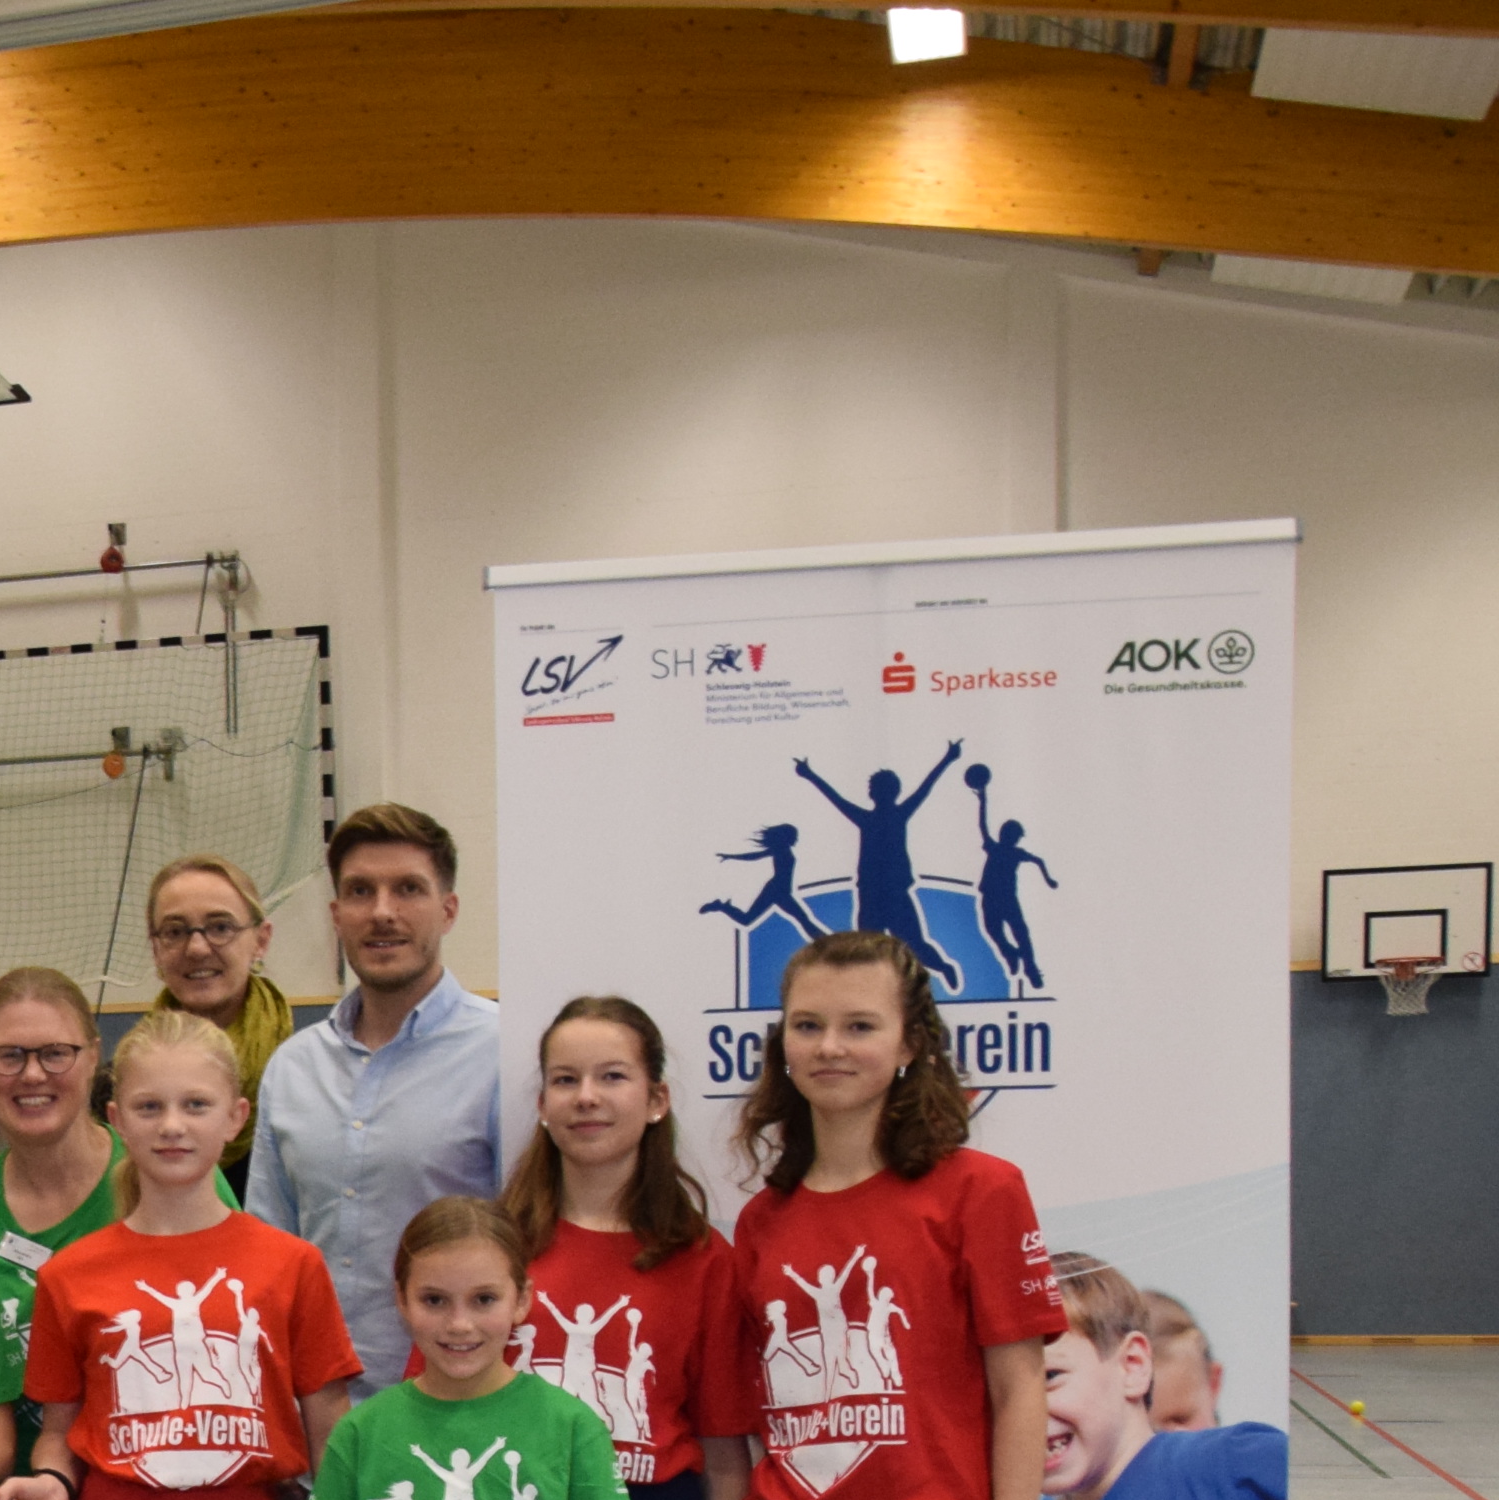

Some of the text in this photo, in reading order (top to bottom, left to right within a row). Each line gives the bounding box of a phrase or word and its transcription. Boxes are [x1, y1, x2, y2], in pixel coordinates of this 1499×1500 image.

[521, 641, 605, 696] LSV
[651, 649, 695, 679] SH
[1106, 638, 1201, 673] AOK
[930, 669, 1057, 696] Sparkasse
[1104, 684, 1125, 695] Die
[109, 1410, 269, 1456] Schule+Verein
[766, 1397, 905, 1447] Schule+Verein
